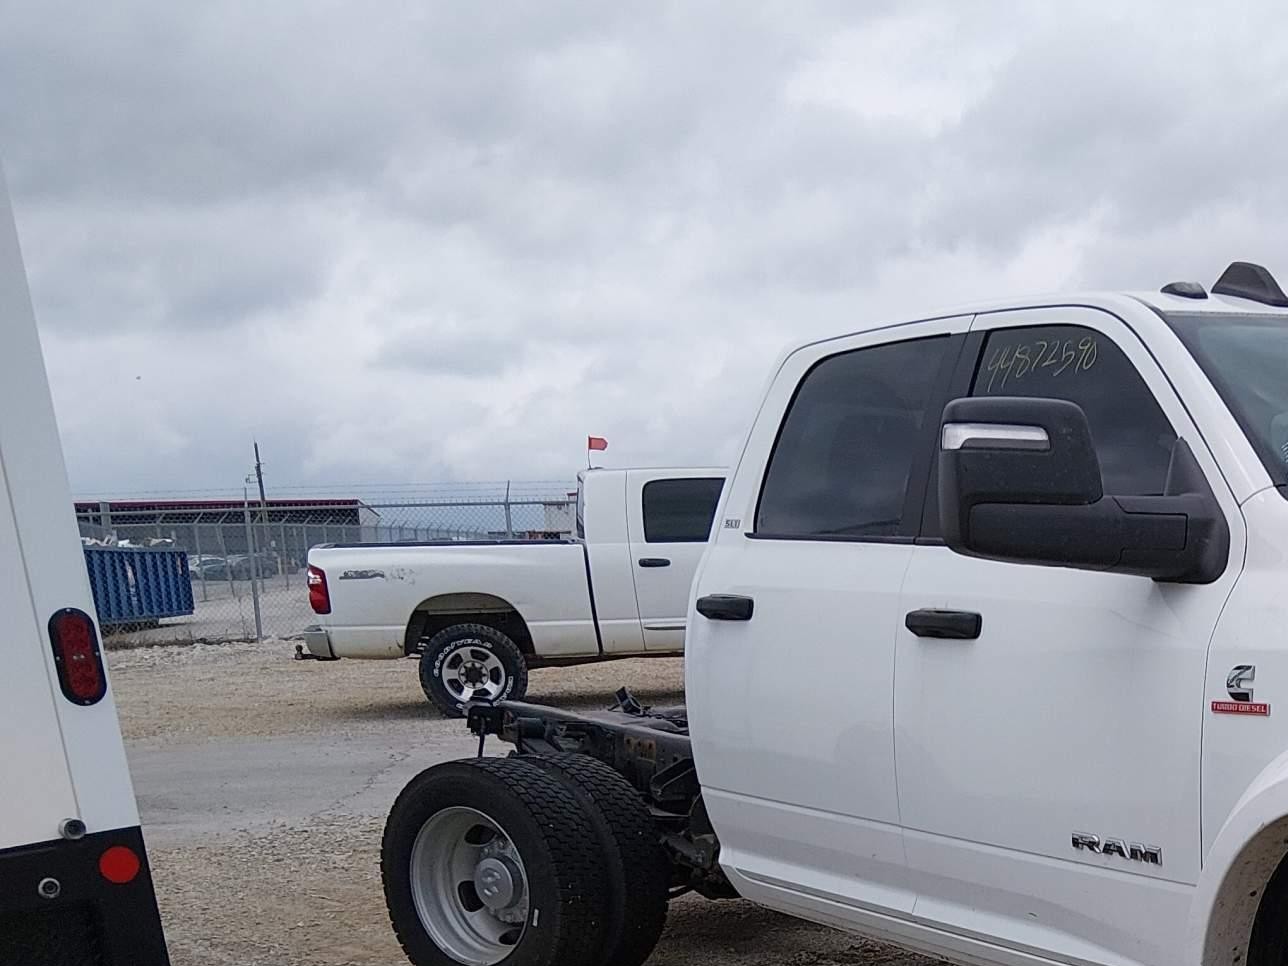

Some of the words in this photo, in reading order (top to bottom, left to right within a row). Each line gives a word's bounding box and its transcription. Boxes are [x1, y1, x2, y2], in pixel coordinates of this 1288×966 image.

[987, 337, 1097, 392] 44872590
[1238, 704, 1267, 713] DIESEL
[1071, 831, 1163, 867] RAM
